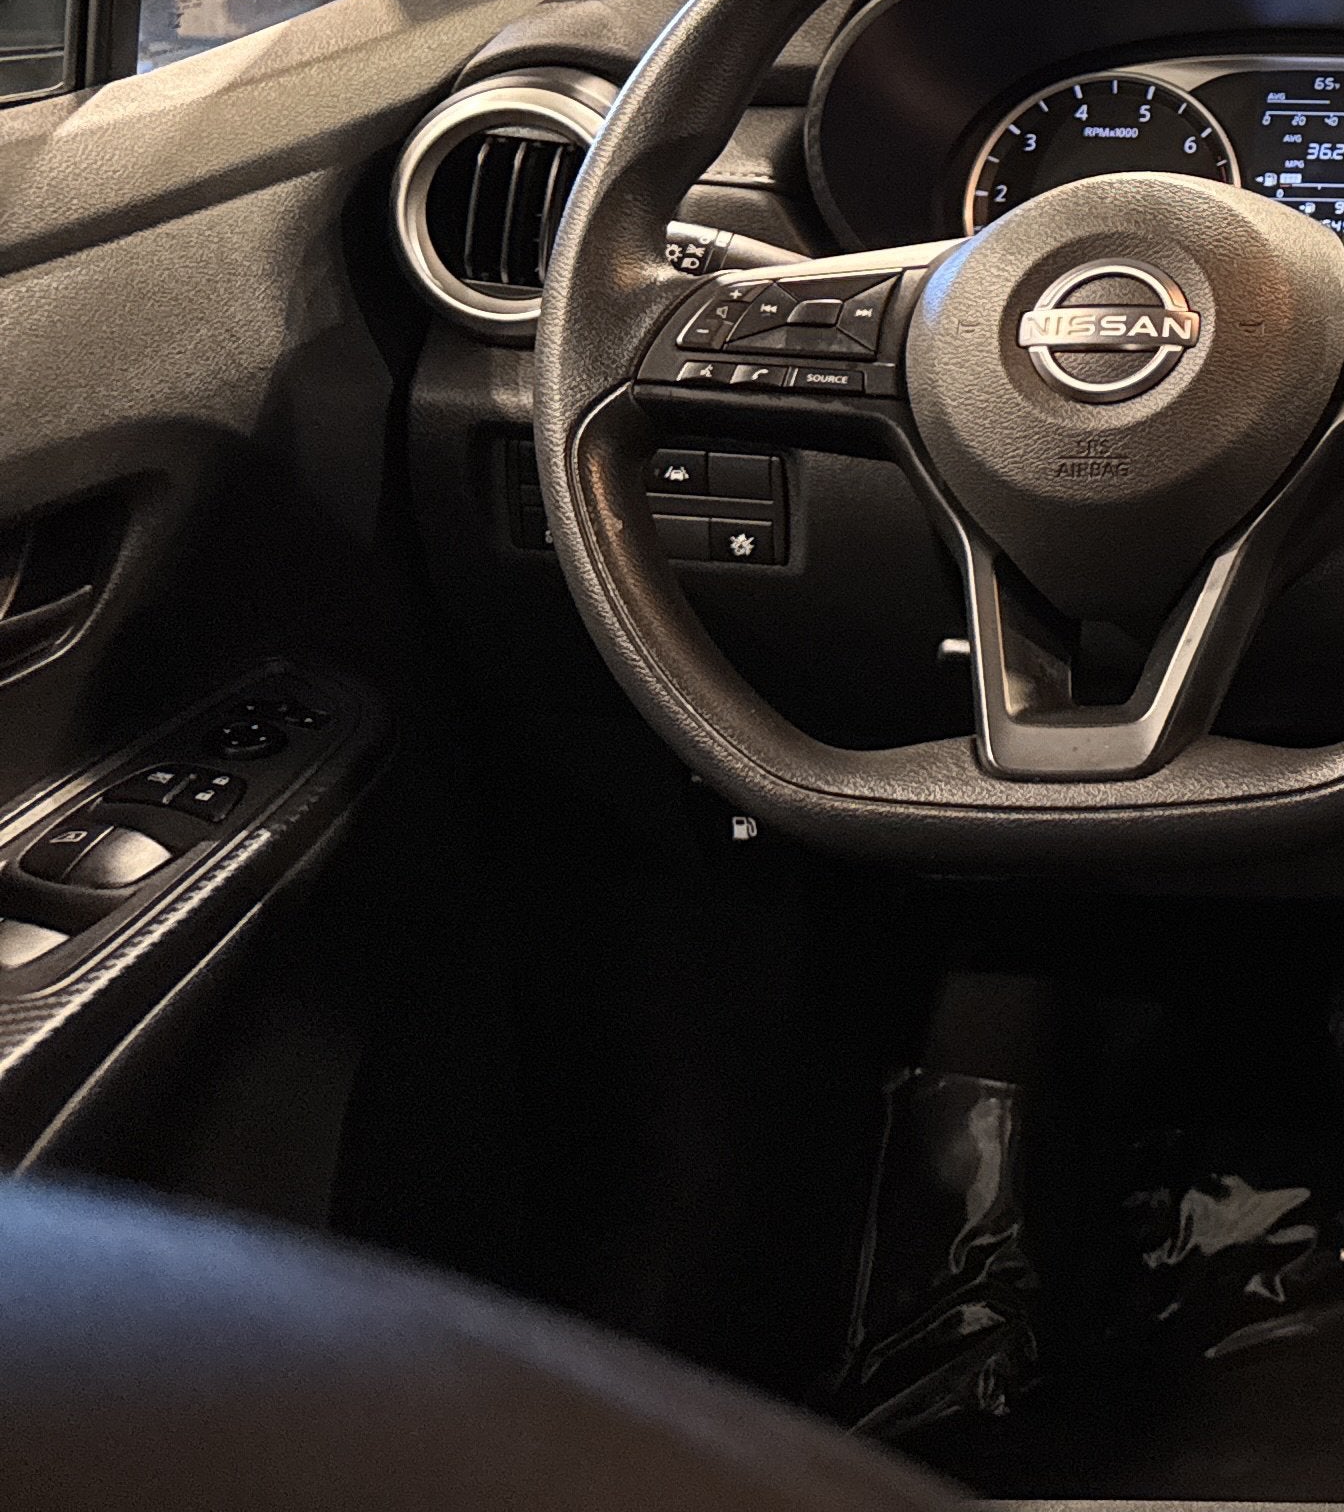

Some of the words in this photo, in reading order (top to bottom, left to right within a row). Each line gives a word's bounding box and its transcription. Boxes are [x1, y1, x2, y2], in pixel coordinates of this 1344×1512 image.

[1267, 92, 1286, 100] AVG
[1074, 104, 1088, 121] 4
[1138, 105, 1151, 123] 5
[1262, 115, 1271, 126] 0
[1291, 115, 1307, 126] 20
[1023, 133, 1037, 152] 3
[1183, 136, 1198, 154] 6
[1282, 134, 1302, 143] AVG
[1284, 160, 1305, 169] MPG
[994, 185, 1008, 202] 2
[1276, 188, 1285, 198] 0
[1028, 315, 1193, 340] NISSAN
[806, 373, 849, 385] SOURCE
[1056, 462, 1130, 478] AIRBAG
